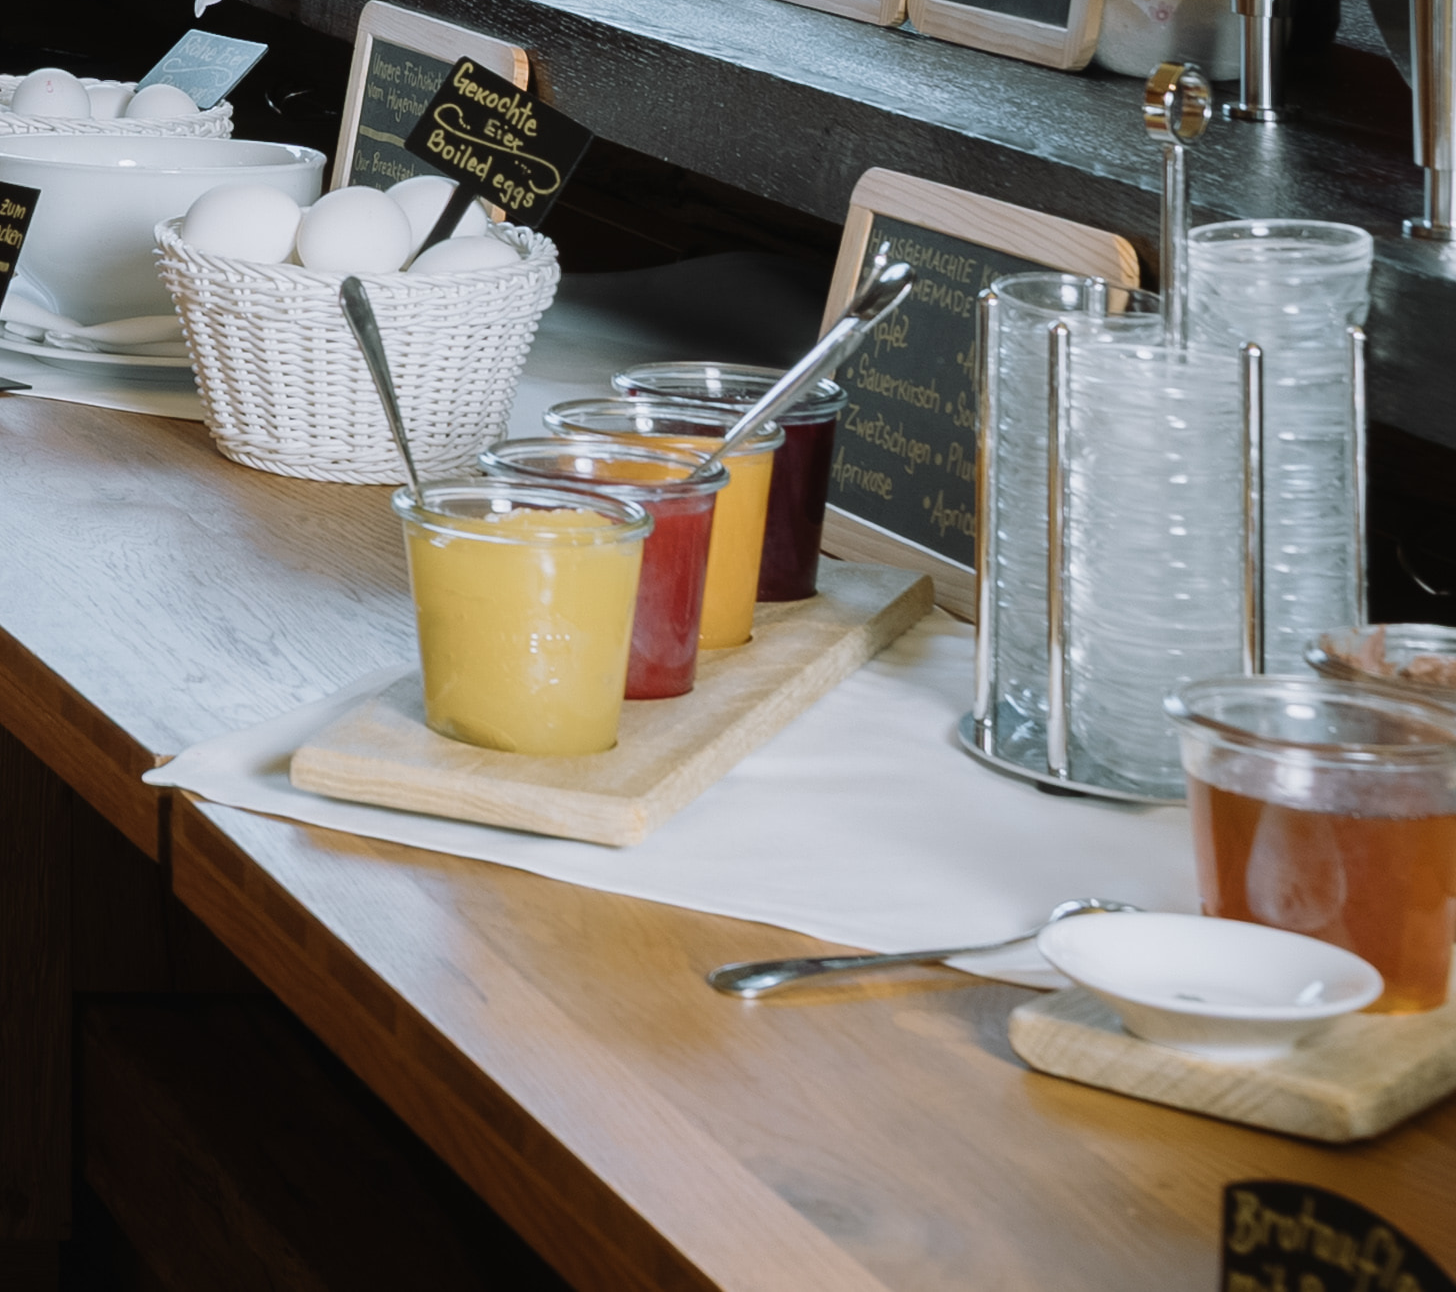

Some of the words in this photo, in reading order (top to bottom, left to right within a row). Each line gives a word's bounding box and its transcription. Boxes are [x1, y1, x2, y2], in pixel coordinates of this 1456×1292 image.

[371, 52, 402, 84] Unsere
[453, 61, 538, 138] Gekochte
[354, 148, 370, 172] Our
[483, 118, 525, 153] Eier
[426, 129, 494, 182] Boiled
[492, 173, 536, 211] eggs
[0, 198, 27, 220] zum
[857, 352, 941, 414] Sauerkirsch
[844, 402, 931, 476] Zwetschgen
[831, 445, 894, 501] Aprikose
